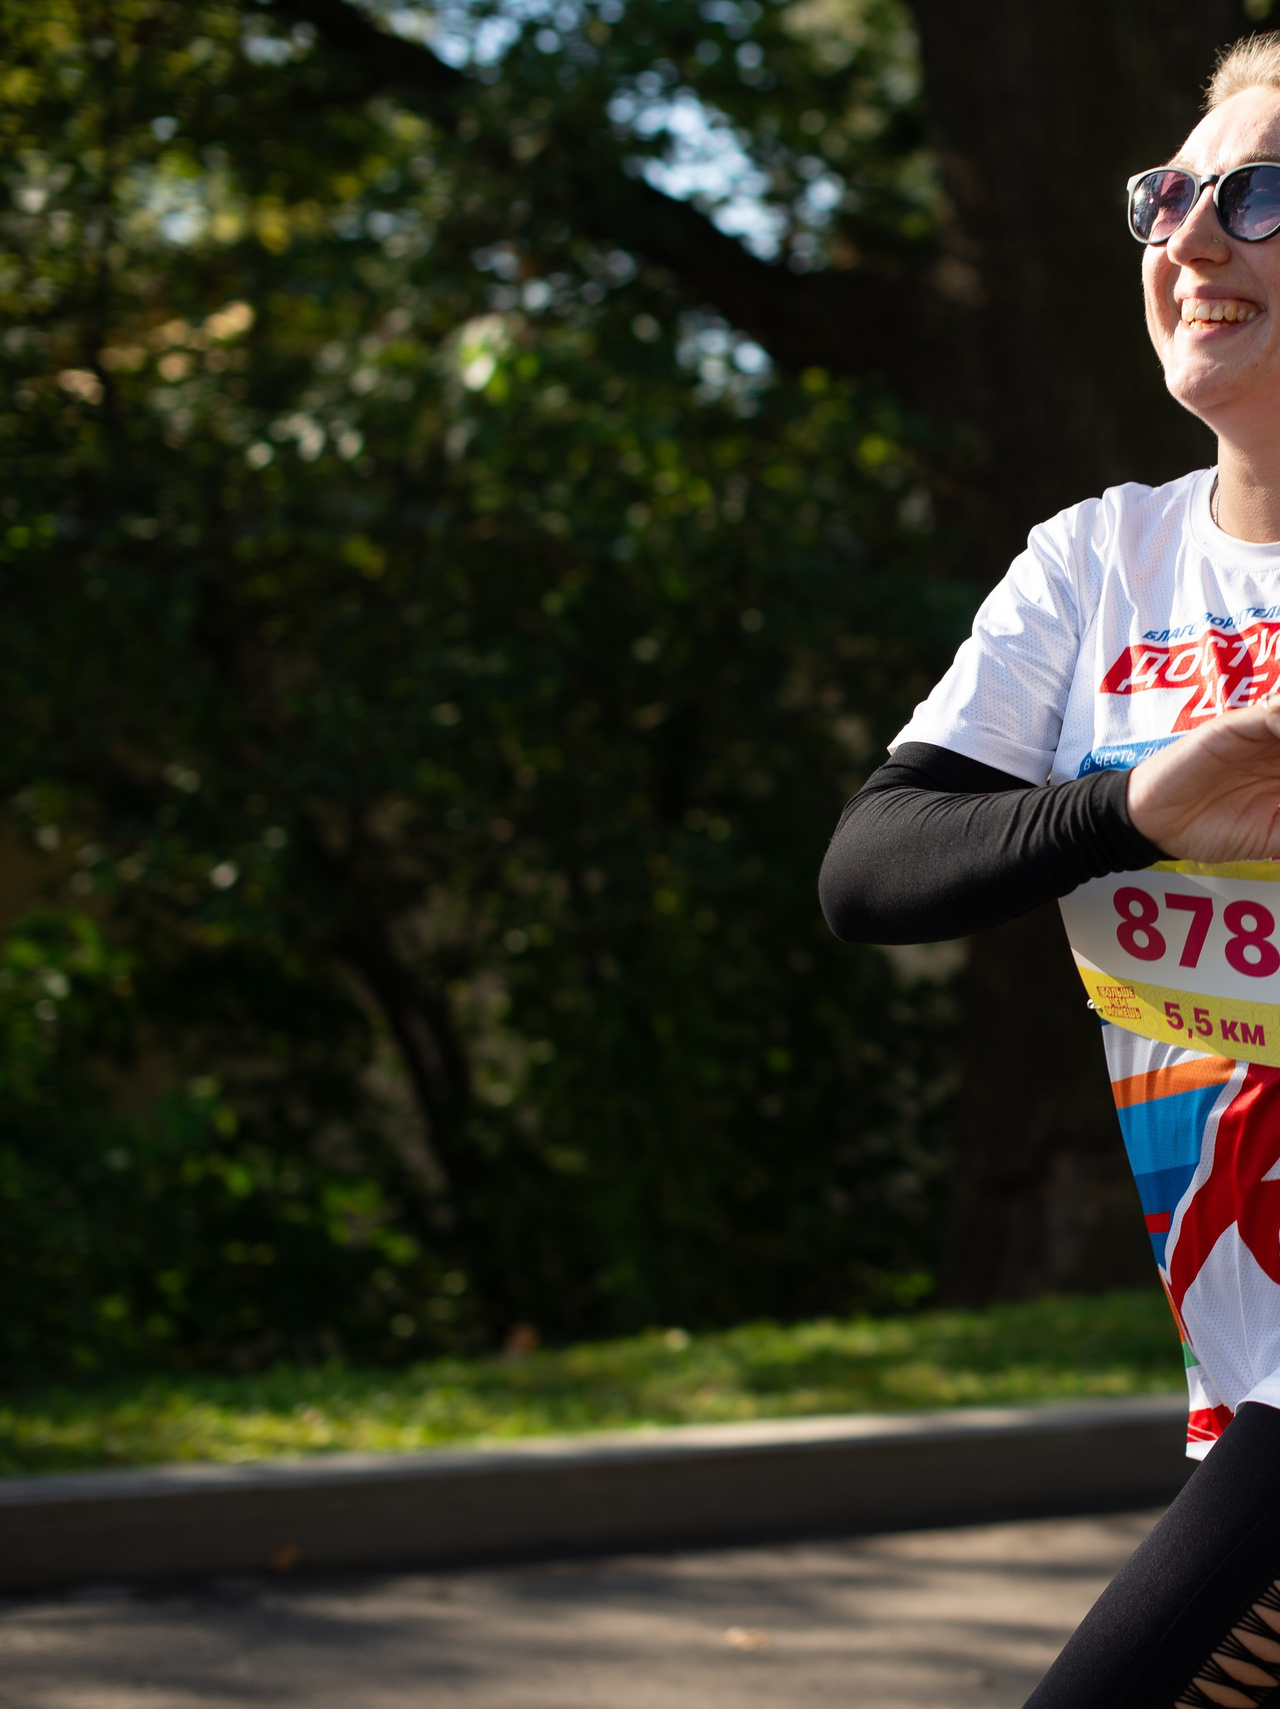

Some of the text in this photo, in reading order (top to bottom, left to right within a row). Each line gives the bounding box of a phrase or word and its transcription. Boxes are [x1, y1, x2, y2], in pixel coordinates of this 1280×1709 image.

[1083, 757, 1092, 771] В
[1095, 749, 1136, 768] ЧЕСТЬ
[1112, 886, 1280, 978] 878
[1164, 1001, 1213, 1039] 5,5
